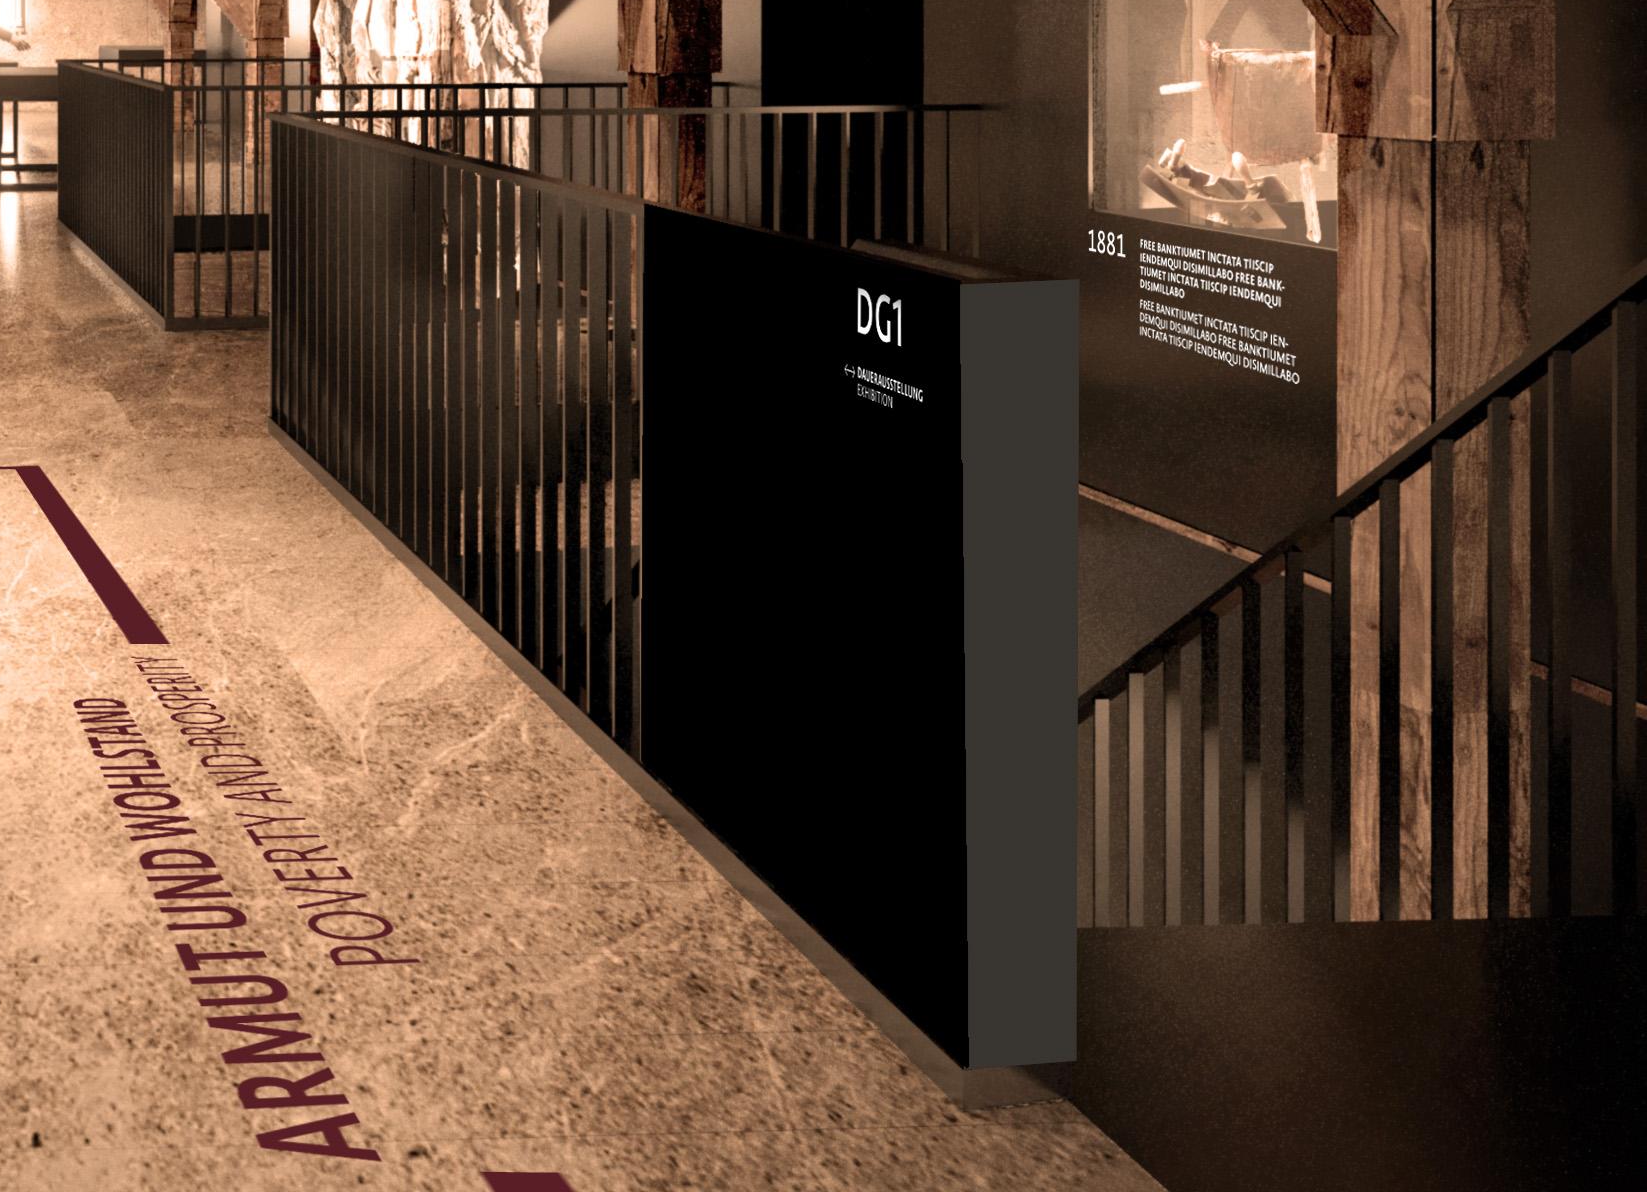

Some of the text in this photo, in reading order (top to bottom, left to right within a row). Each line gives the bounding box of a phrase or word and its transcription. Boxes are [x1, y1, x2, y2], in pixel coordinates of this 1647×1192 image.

[1088, 229, 1126, 257] 1881
[1140, 238, 1156, 251] FREE
[1157, 242, 1205, 260] BANKTIUMET
[1208, 251, 1241, 267] INCTATA
[1140, 253, 1285, 291] IENDEMQUI DISIMILLABO FREE BANK-
[1140, 266, 1166, 281] TIUMET
[1168, 272, 1199, 288] INCTATA
[1229, 285, 1282, 308] IENDEMQUI
[1140, 279, 1185, 299] DISIMILLABO
[857, 288, 901, 346] DG1
[1140, 299, 1154, 312] FREE
[1156, 303, 1202, 325] BANKTIUMET
[1205, 314, 1237, 335] INCTATA
[1270, 334, 1288, 348] IEN-
[1140, 312, 1296, 366] DEMQUI DISIMILLABO FREE BANKTIUMET
[1140, 326, 1168, 343] INCTATA
[1194, 342, 1241, 367] IENDEMQUI
[1243, 357, 1300, 384] DISIMILLABO
[857, 366, 923, 402] DAUERAUSSTELLUNG
[857, 383, 893, 408] EXHIBITION
[131, 656, 420, 966] POVERTY AND PROSPERITY
[73, 698, 381, 1161] ARMUT UND WOHLSTAND
